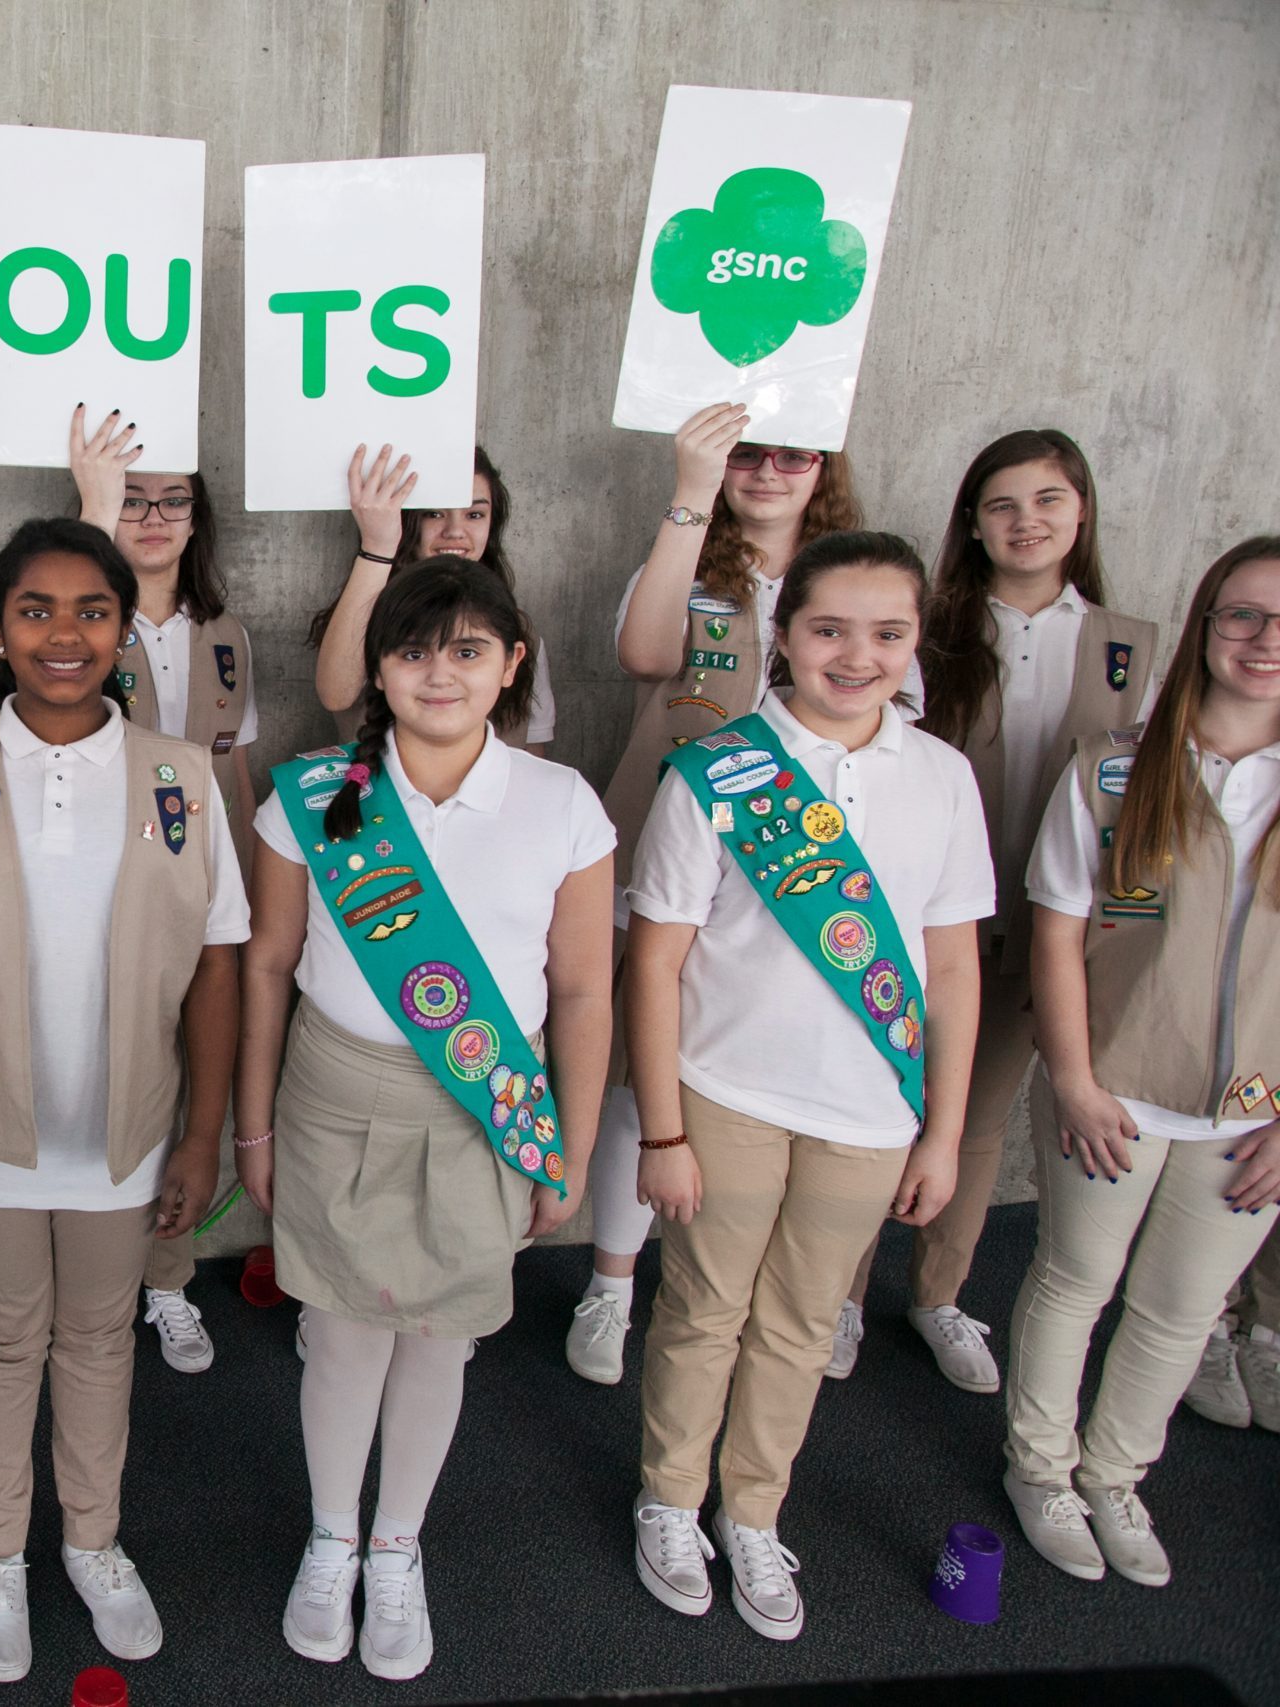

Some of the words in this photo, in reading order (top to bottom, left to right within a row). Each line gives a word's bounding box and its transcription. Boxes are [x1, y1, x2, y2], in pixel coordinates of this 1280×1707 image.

[707, 248, 808, 283] gsnc
[268, 284, 452, 399] TS
[696, 652, 734, 668] 314
[762, 819, 791, 842] 42
[353, 900, 386, 920] JUNIOR
[390, 888, 412, 902] AIDE
